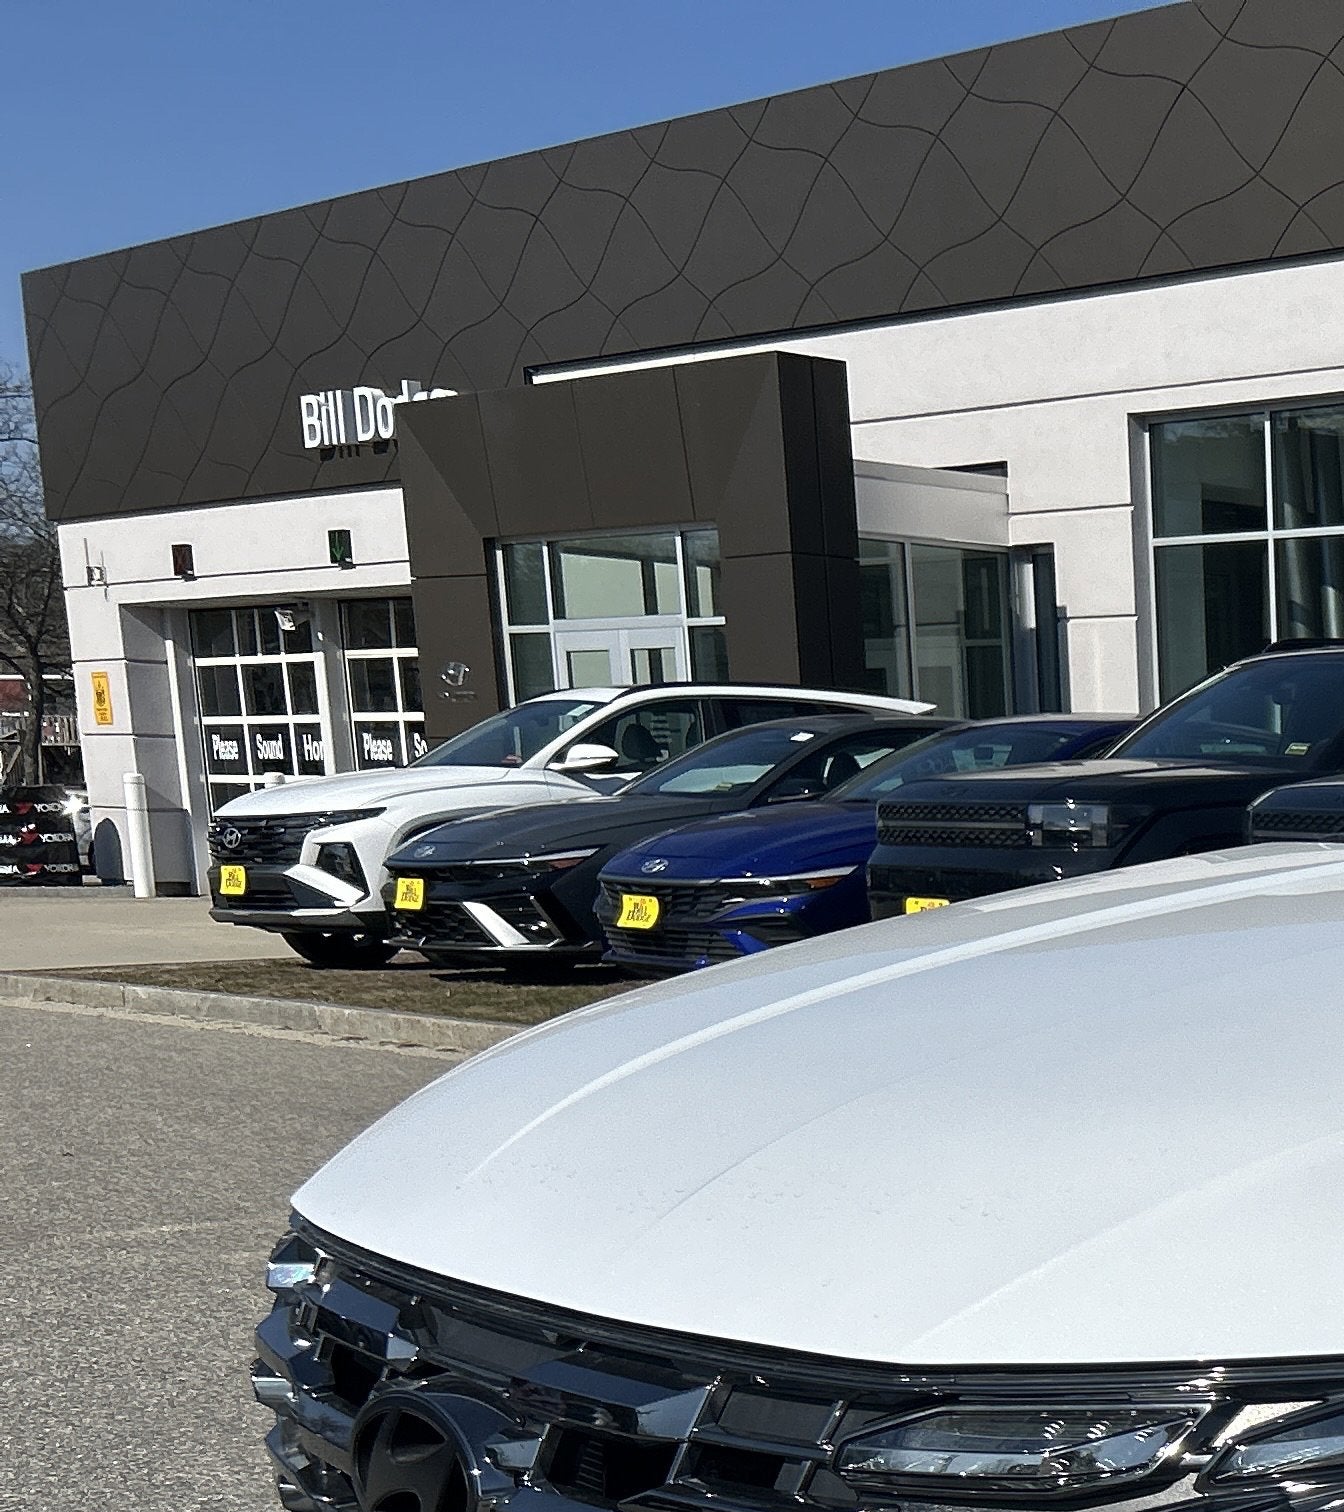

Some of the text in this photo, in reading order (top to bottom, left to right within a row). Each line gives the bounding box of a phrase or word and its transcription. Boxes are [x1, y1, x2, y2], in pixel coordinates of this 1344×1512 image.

[301, 389, 347, 449] Bill
[212, 733, 325, 761] Please Sound Hor
[362, 732, 392, 760] Please
